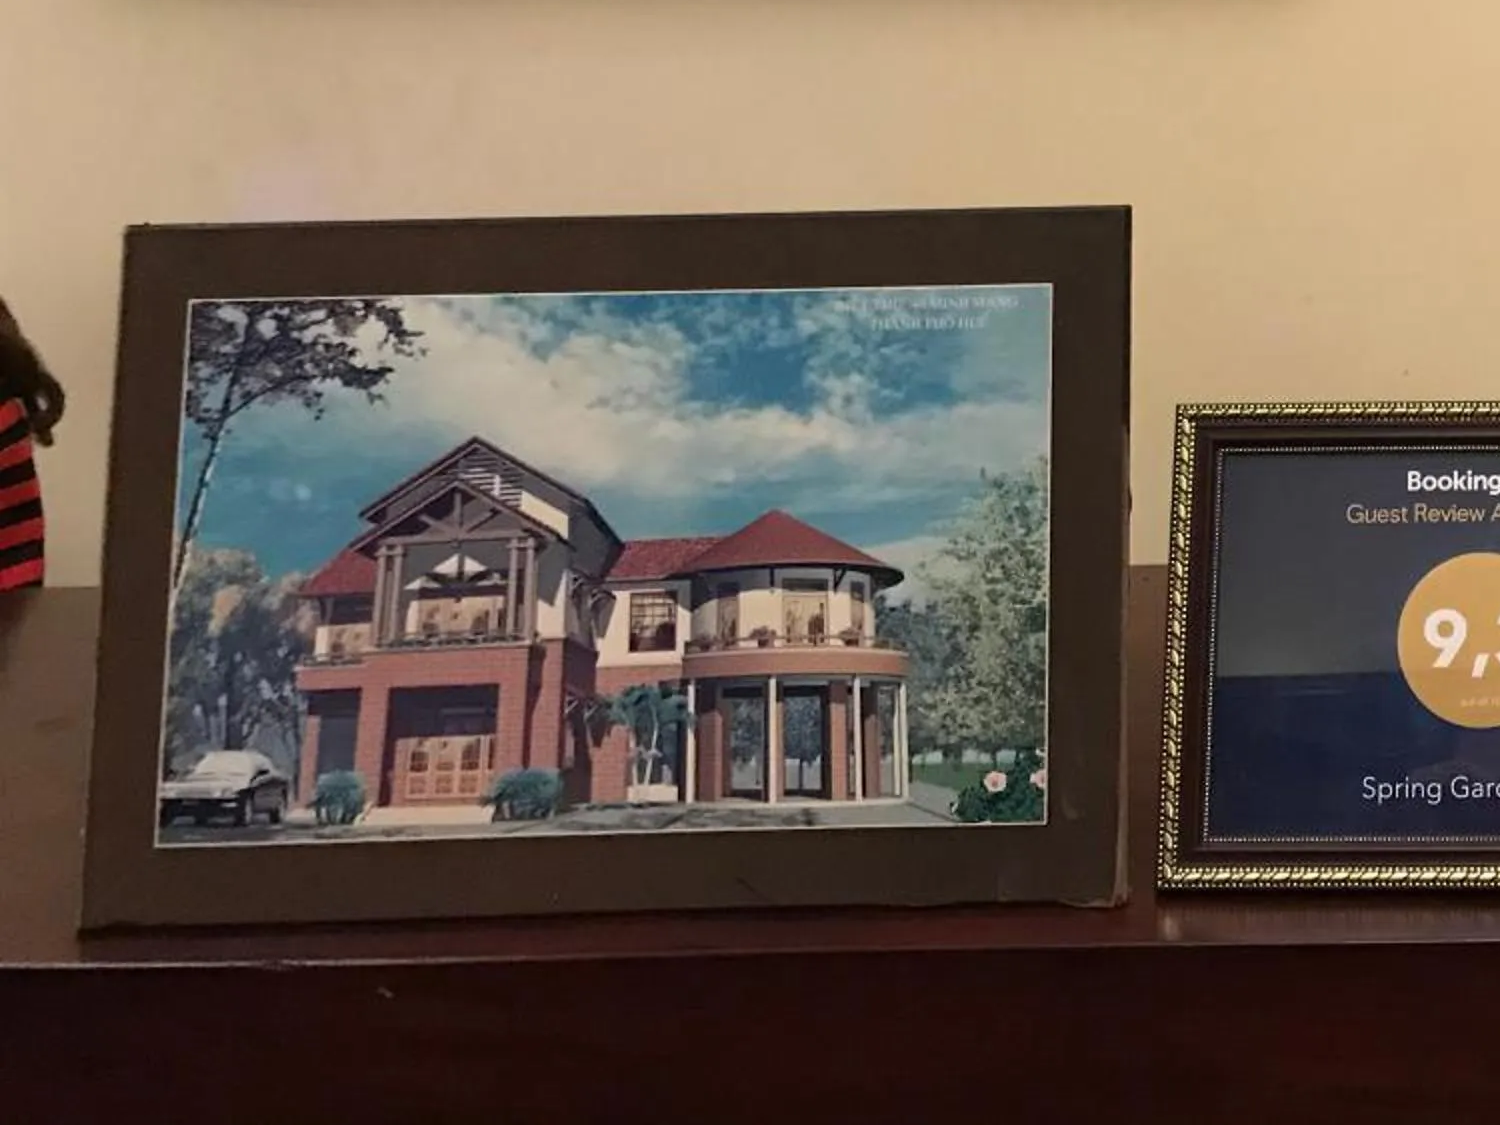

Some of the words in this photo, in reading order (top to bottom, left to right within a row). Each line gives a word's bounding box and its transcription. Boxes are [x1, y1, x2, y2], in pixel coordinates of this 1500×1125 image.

[1346, 503, 1408, 524] Guest
[1413, 502, 1486, 523] Review
[1361, 775, 1443, 806] Spring
